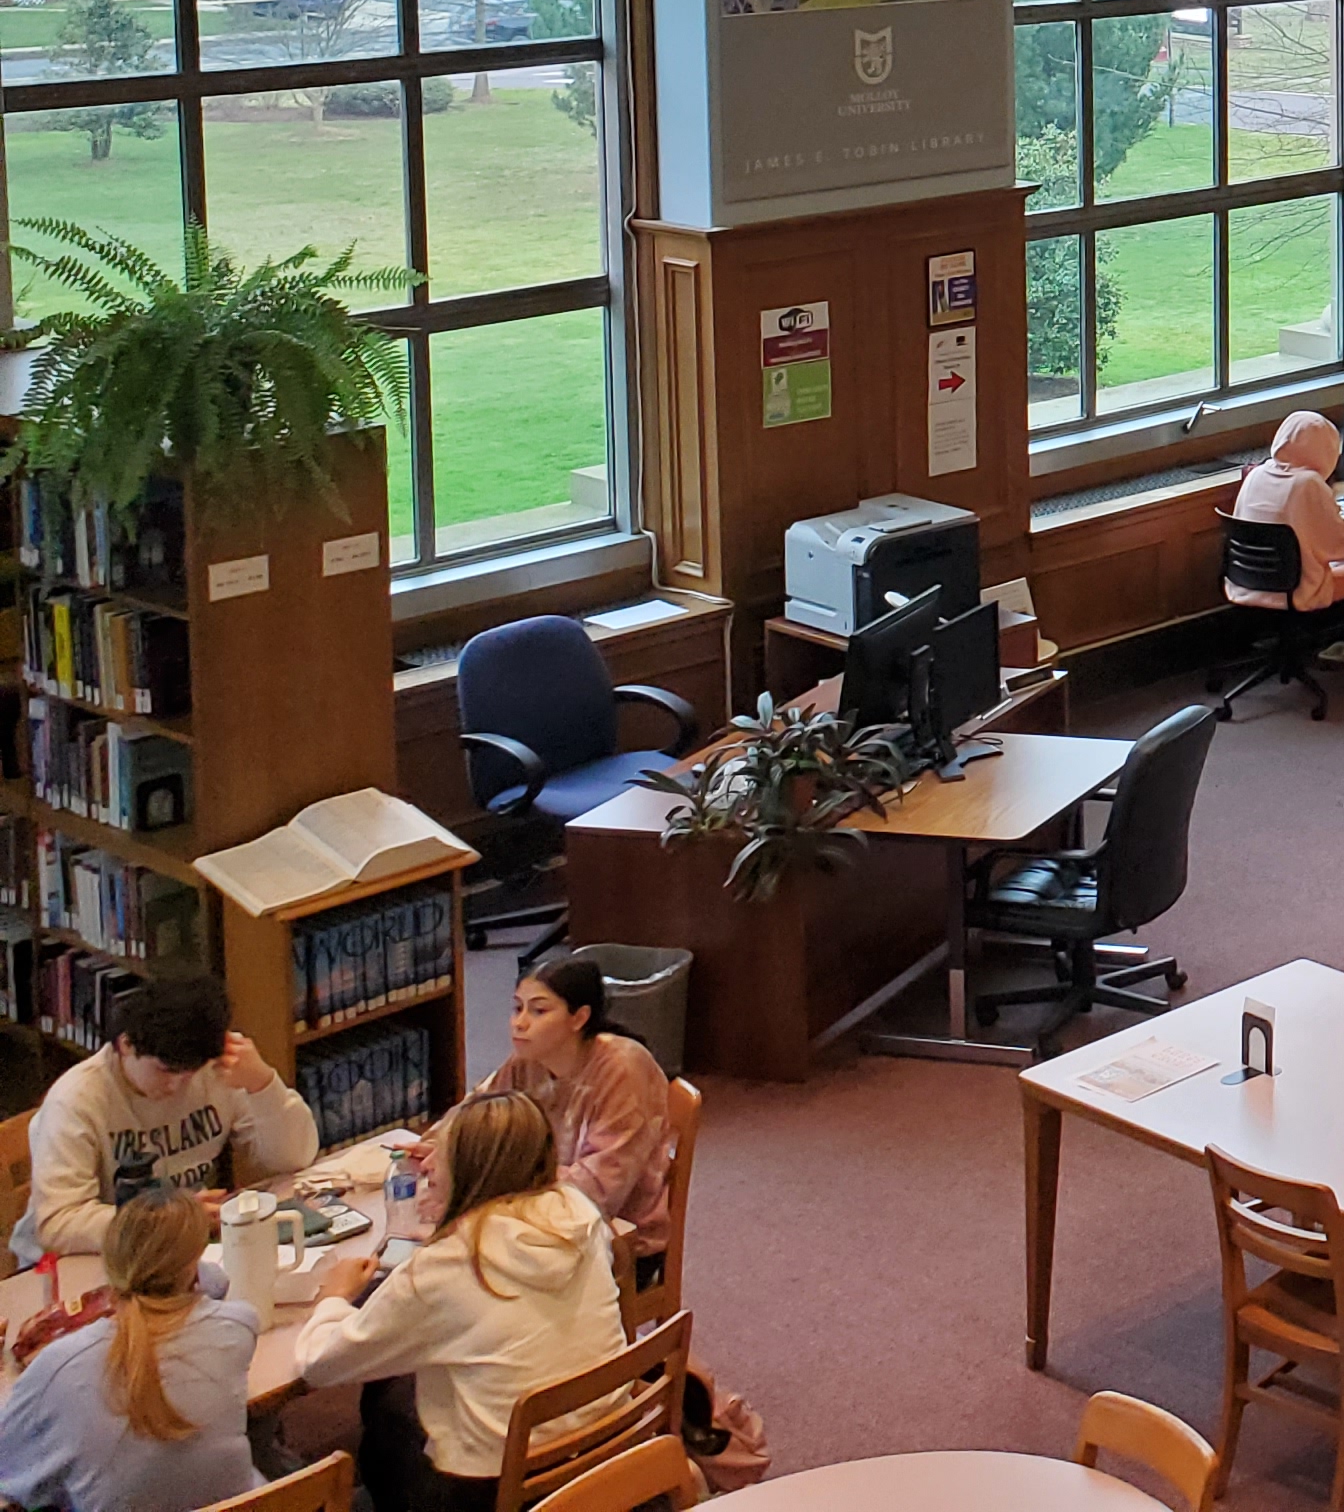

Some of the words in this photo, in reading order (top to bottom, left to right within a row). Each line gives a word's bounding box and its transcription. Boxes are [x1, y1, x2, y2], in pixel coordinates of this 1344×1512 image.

[837, 98, 913, 117] UNIVERSITY
[745, 152, 805, 175] JAMES
[842, 143, 900, 160] TOBIN
[911, 132, 986, 152] LIBRARY
